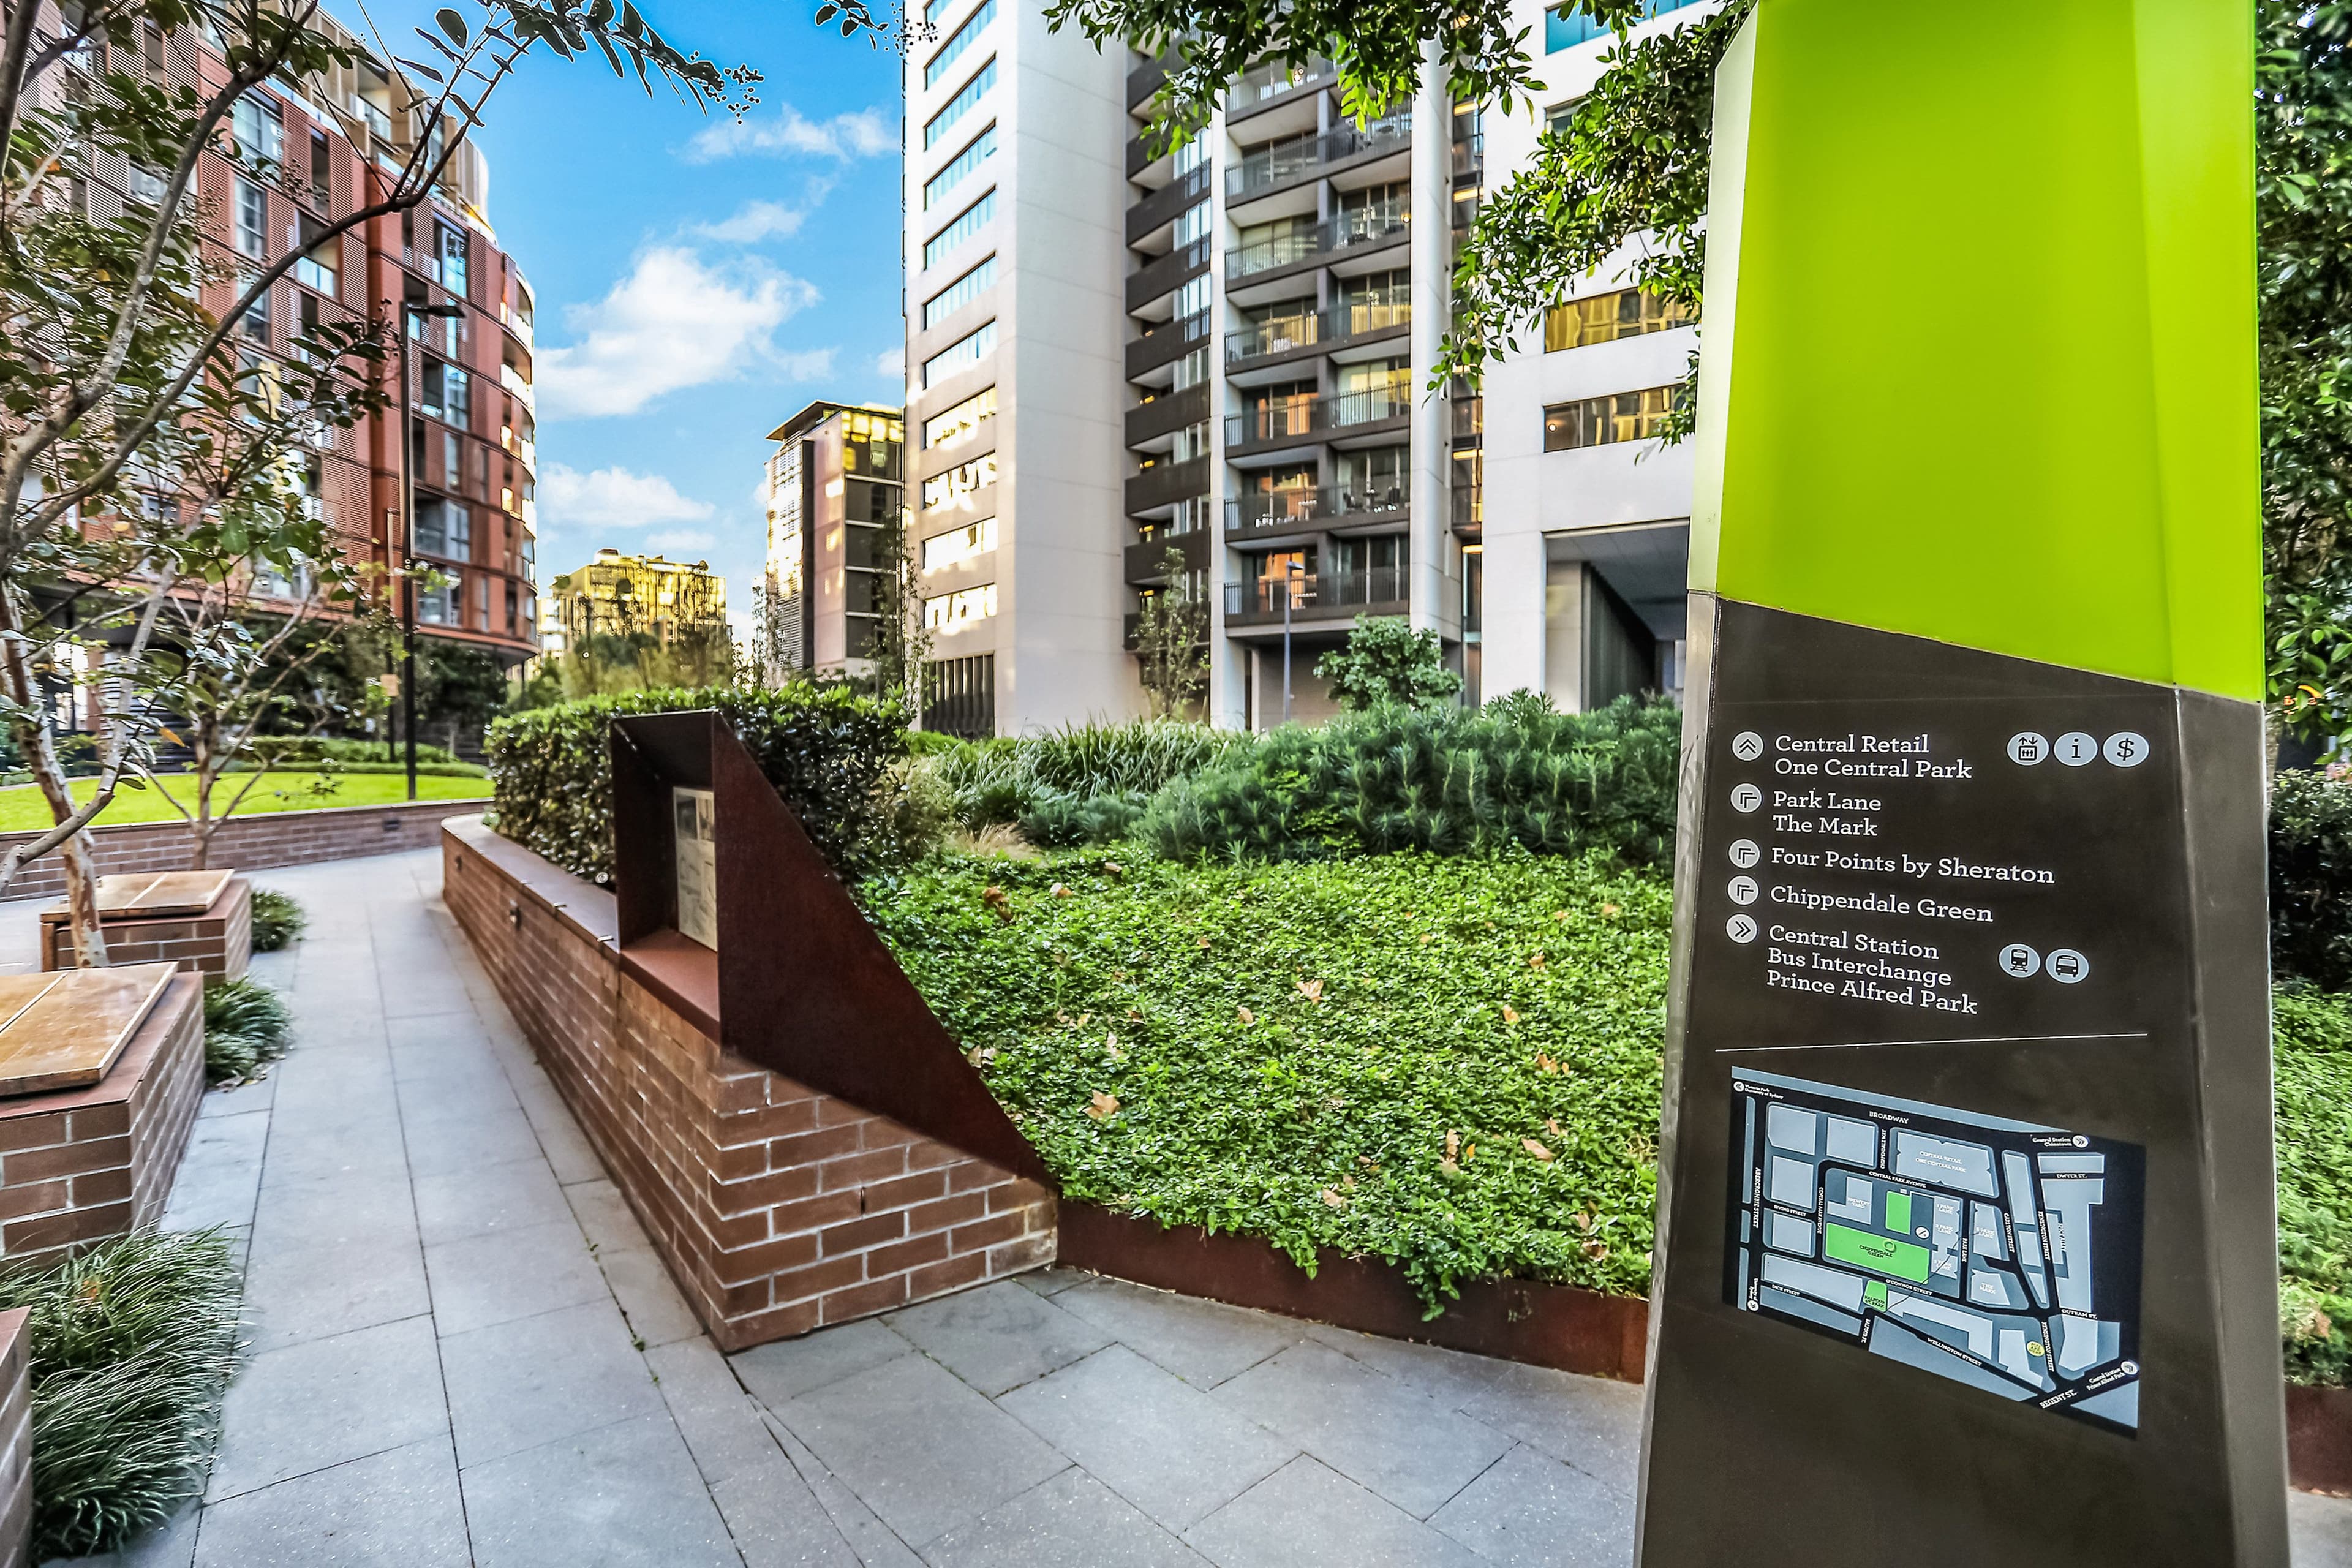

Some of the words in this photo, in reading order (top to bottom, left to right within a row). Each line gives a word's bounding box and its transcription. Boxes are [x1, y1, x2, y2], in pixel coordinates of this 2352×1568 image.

[1775, 734, 1855, 752] Central
[1861, 734, 1929, 753] Retail
[1774, 758, 1819, 775] One
[1824, 758, 1909, 777] Central
[1915, 760, 1972, 779] Park
[1773, 790, 1822, 809] Park
[1827, 793, 1882, 811] Lane
[1773, 814, 1812, 832] The
[1818, 817, 1877, 836] Mark
[1771, 847, 1820, 866] Four
[1825, 851, 1896, 873] Points
[1902, 854, 1932, 878] by
[1937, 858, 2055, 884] Sheraton
[1770, 886, 1910, 914] Chippendale
[1917, 899, 1993, 922] Green
[1769, 925, 1849, 949] Central
[1854, 933, 1939, 960] Station
[1768, 947, 1806, 967] Bus
[1811, 952, 1952, 988] Interchange
[1767, 969, 1835, 993] Prince
[1840, 980, 1913, 1005] Alfred
[1920, 990, 1978, 1014] Park
[1869, 1111, 1909, 1124] BROADWAY
[1869, 1171, 1891, 1180] CENTRAL
[1886, 1279, 1913, 1290] O'CONNOR
[1913, 1287, 1932, 1296] STREET
[2061, 1309, 2088, 1317] OUTRAM
[1928, 1337, 1962, 1357] WELLINGTON
[1962, 1354, 1983, 1366] STREET
[2039, 1393, 2067, 1409] REGENT
[2064, 1389, 2078, 1399] ST.
